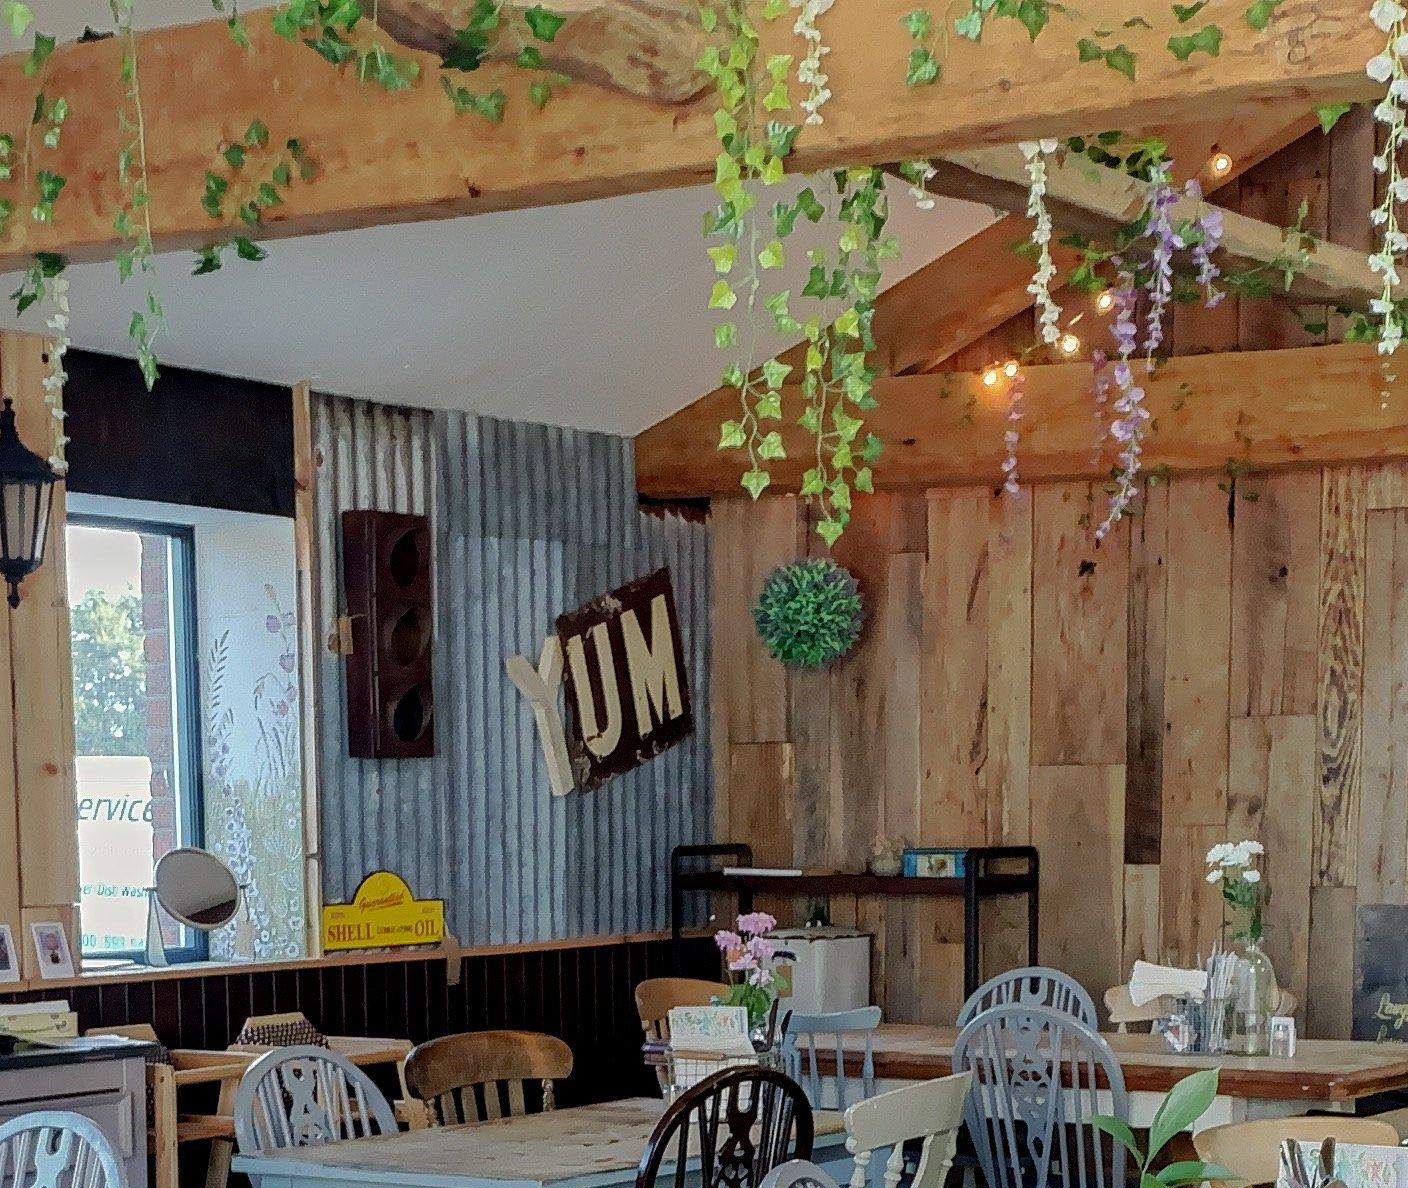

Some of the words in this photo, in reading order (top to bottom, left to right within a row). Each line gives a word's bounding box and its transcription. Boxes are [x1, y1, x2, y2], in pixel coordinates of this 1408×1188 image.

[506, 594, 683, 797] YUM
[327, 921, 375, 943] SHELL
[414, 919, 439, 938] OIL
